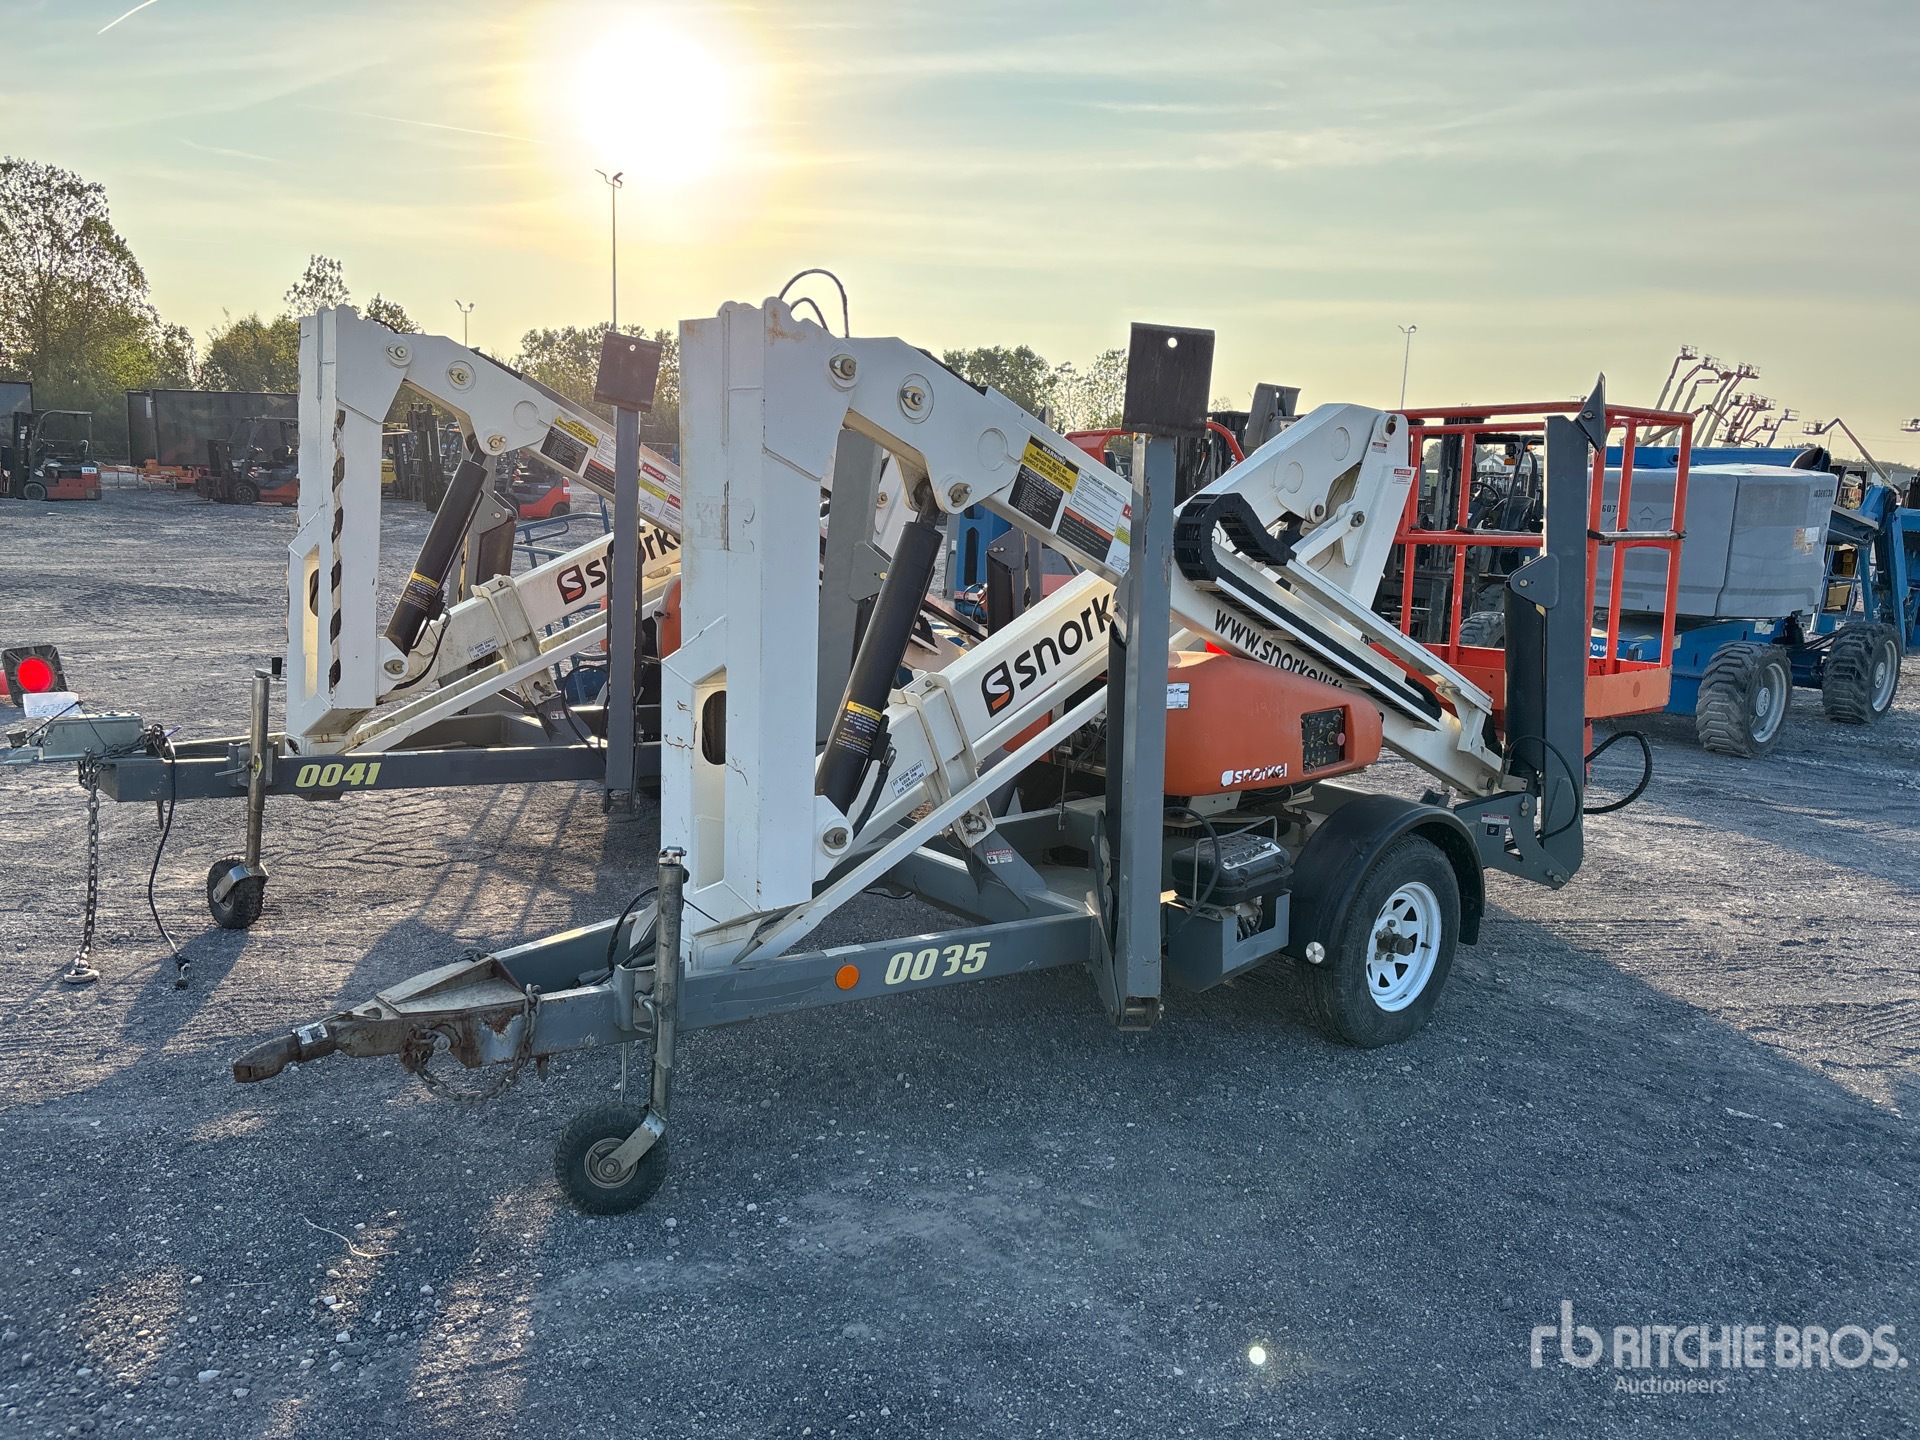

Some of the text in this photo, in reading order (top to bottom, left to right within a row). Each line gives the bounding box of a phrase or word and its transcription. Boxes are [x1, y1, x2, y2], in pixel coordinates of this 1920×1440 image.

[1029, 452, 1071, 483] REMOVED FROM TOWING
[1042, 445, 1067, 465] WARNING
[646, 467, 665, 481] DANGER
[1024, 456, 1072, 490] VEHICLE BEFORE OPERATING
[295, 762, 382, 788] 0041
[884, 941, 992, 986] 0035
